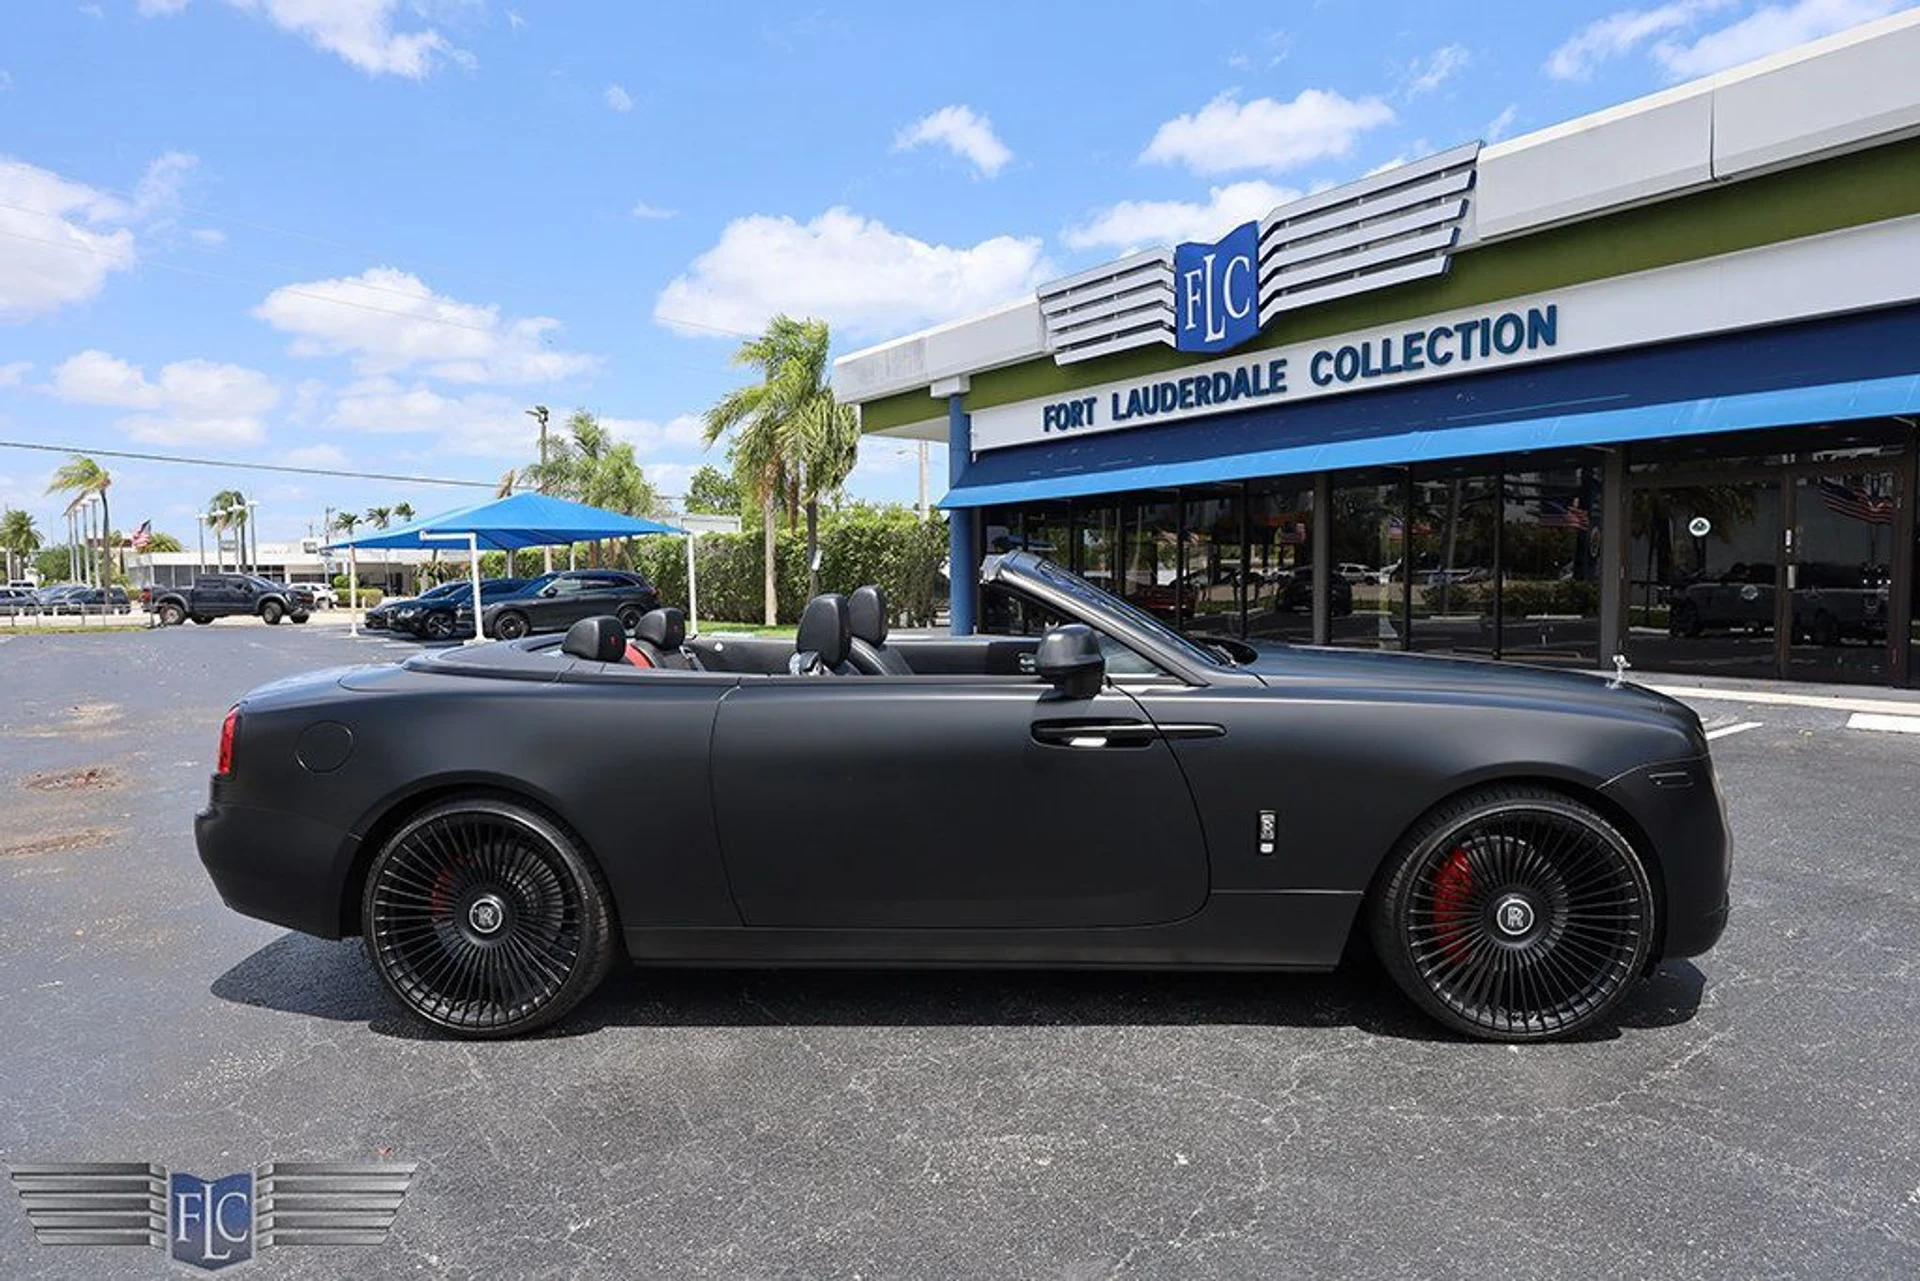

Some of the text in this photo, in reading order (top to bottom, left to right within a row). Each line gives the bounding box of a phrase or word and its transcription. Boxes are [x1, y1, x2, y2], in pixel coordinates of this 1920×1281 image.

[1183, 253, 1251, 343] FLC
[1042, 304, 1558, 433] FORT LAUDERDALE COLLECTION
